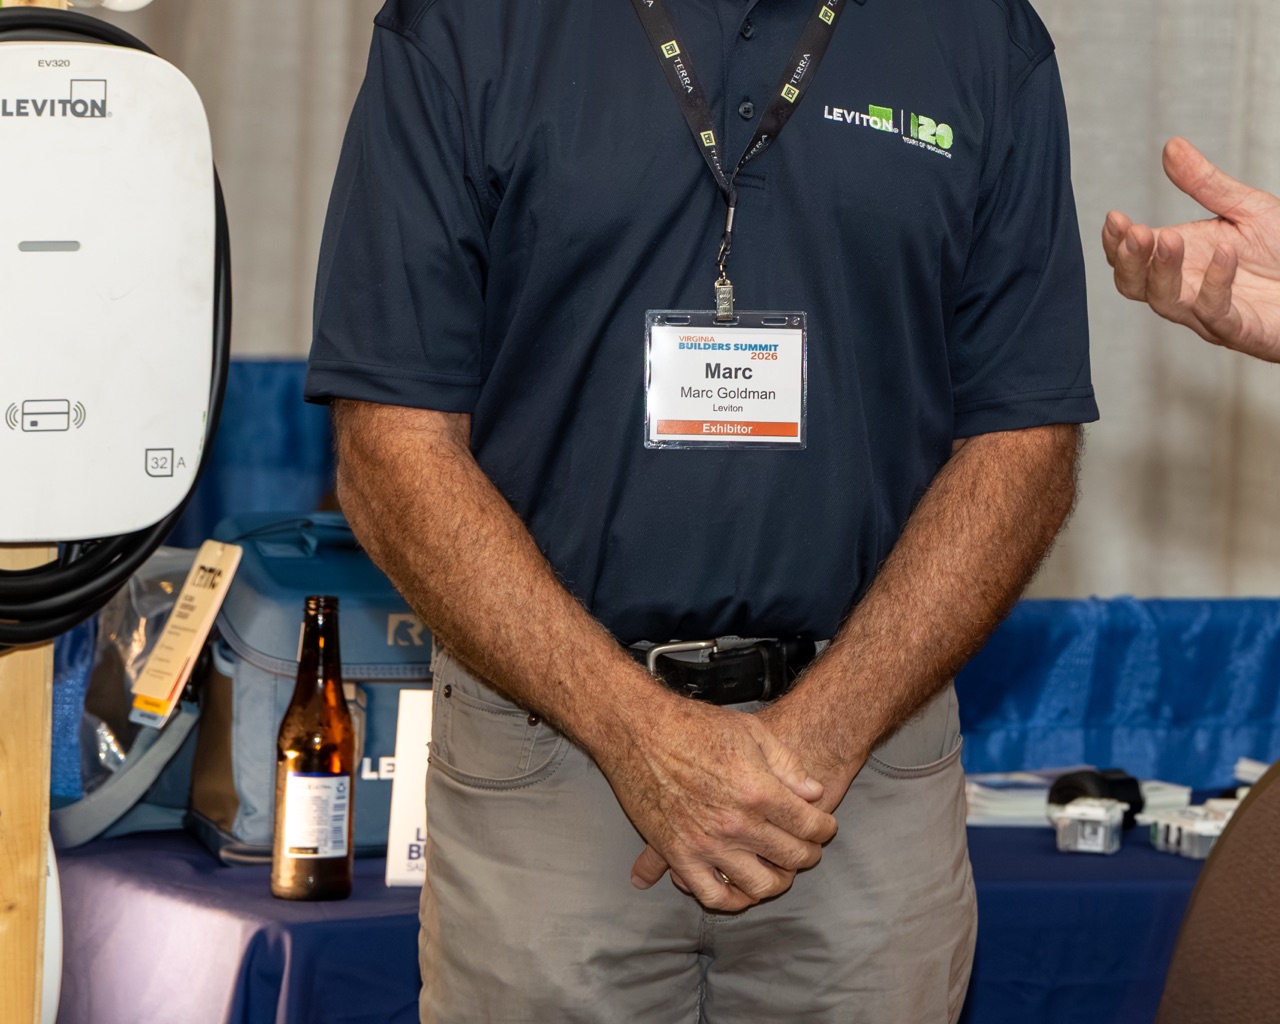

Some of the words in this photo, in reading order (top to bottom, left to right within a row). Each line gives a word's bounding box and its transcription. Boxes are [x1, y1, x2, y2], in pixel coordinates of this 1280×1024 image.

[38, 59, 70, 68] EV320
[790, 53, 811, 85] TERRA
[674, 56, 694, 94] TERRA
[2, 98, 106, 117] LEVITON
[824, 105, 893, 132] LEVITON
[910, 112, 953, 150] 120
[678, 342, 731, 351] BUILDERS
[733, 344, 779, 352] SUMMIT
[750, 352, 778, 360] 2026
[705, 362, 753, 379] Marc
[680, 386, 713, 399] Marc
[717, 387, 776, 400] Goldman
[712, 404, 743, 412] Leviton
[702, 423, 753, 434] Exhibitor
[151, 457, 168, 469] 32
[176, 456, 186, 468] A
